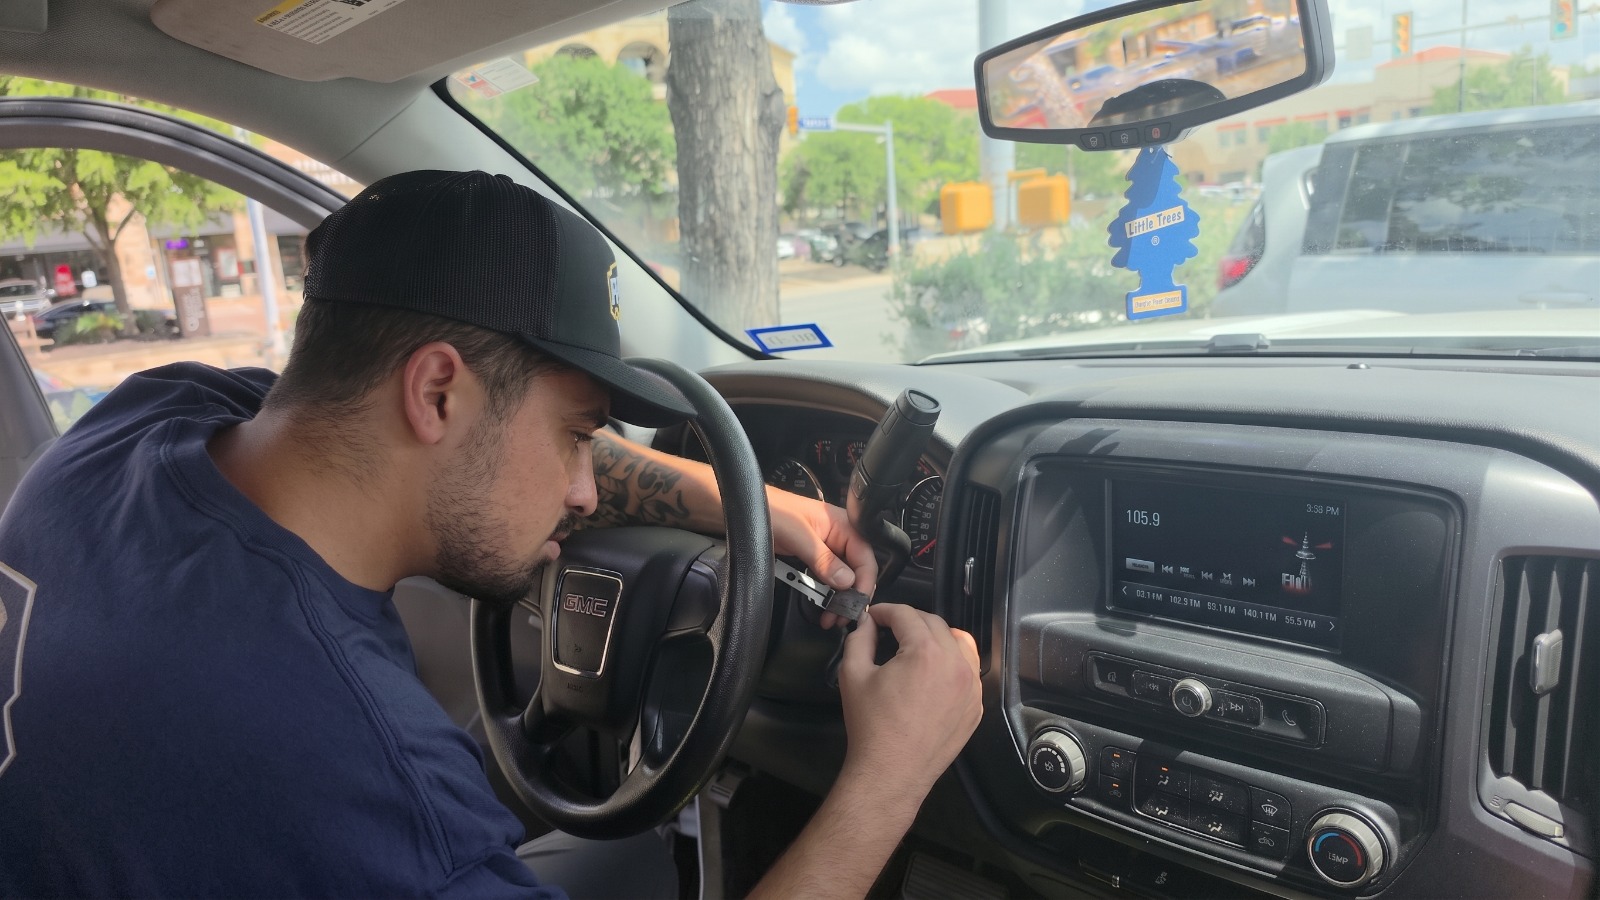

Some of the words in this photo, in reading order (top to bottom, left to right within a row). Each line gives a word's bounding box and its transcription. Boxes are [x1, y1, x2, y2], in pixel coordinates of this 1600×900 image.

[1128, 217, 1154, 236] Little
[1157, 211, 1182, 227] Trees
[921, 511, 932, 519] 30
[1325, 505, 1340, 516] PM
[1126, 509, 1160, 527] 105.9
[920, 522, 930, 530] 20
[563, 593, 608, 618] GMC
[1284, 615, 1302, 626] 55.5
